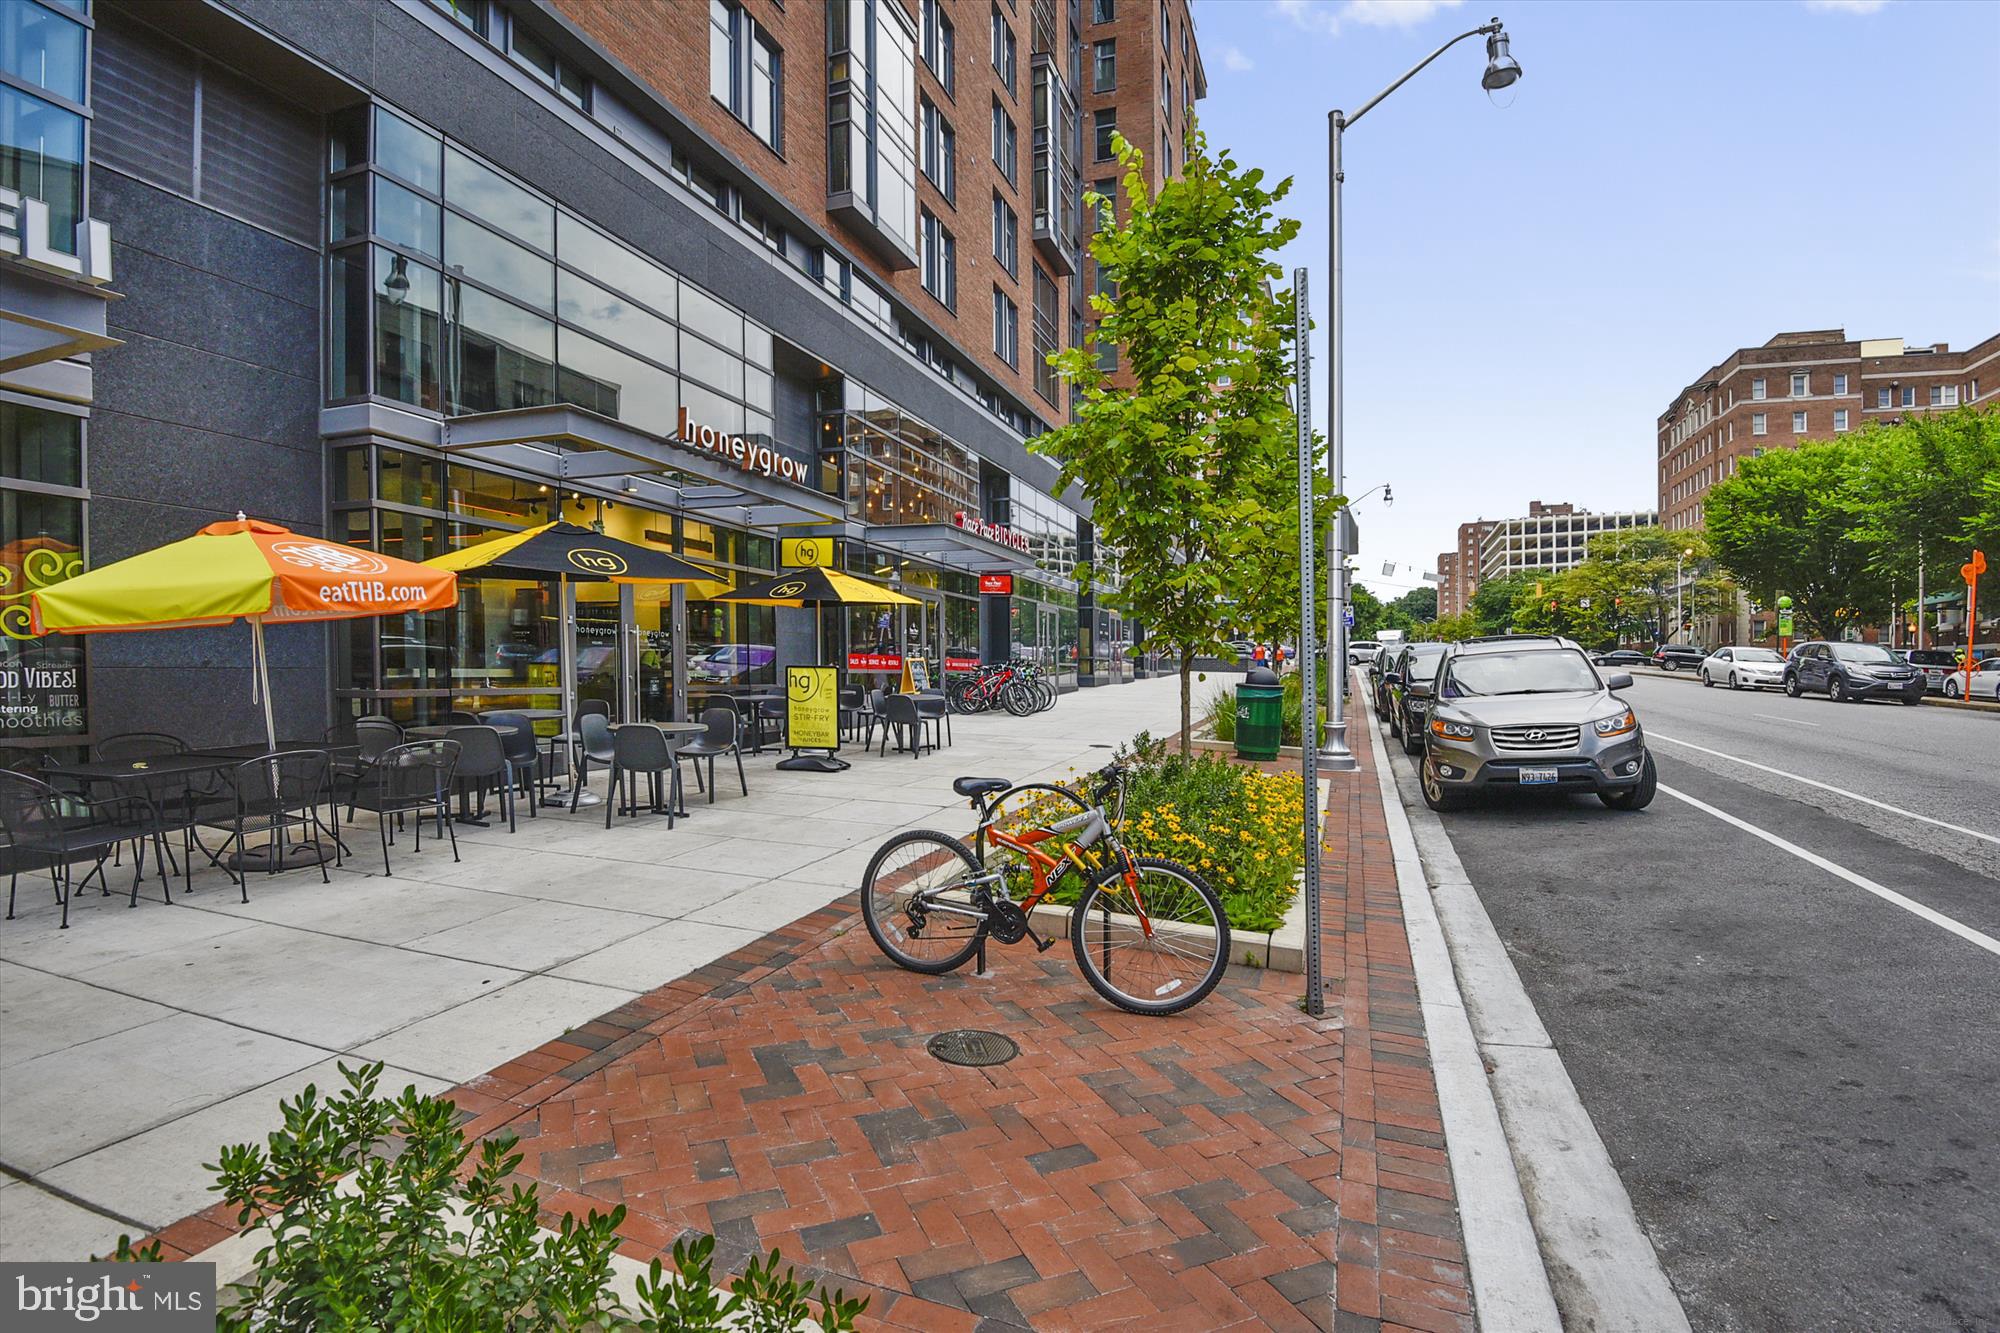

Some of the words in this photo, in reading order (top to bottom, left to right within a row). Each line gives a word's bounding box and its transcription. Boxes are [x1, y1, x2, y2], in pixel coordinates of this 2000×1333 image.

[683, 406, 808, 484] honeygrow
[994, 523, 1031, 555] BICYCLES
[800, 545, 814, 560] hg
[576, 553, 617, 570] hg
[319, 581, 428, 602] eatTHB.com
[776, 585, 800, 594] hg
[636, 629, 670, 638] oneygrow
[789, 668, 811, 694] hg
[49, 694, 80, 707] BUTTER
[793, 713, 830, 722] STIR-FRY
